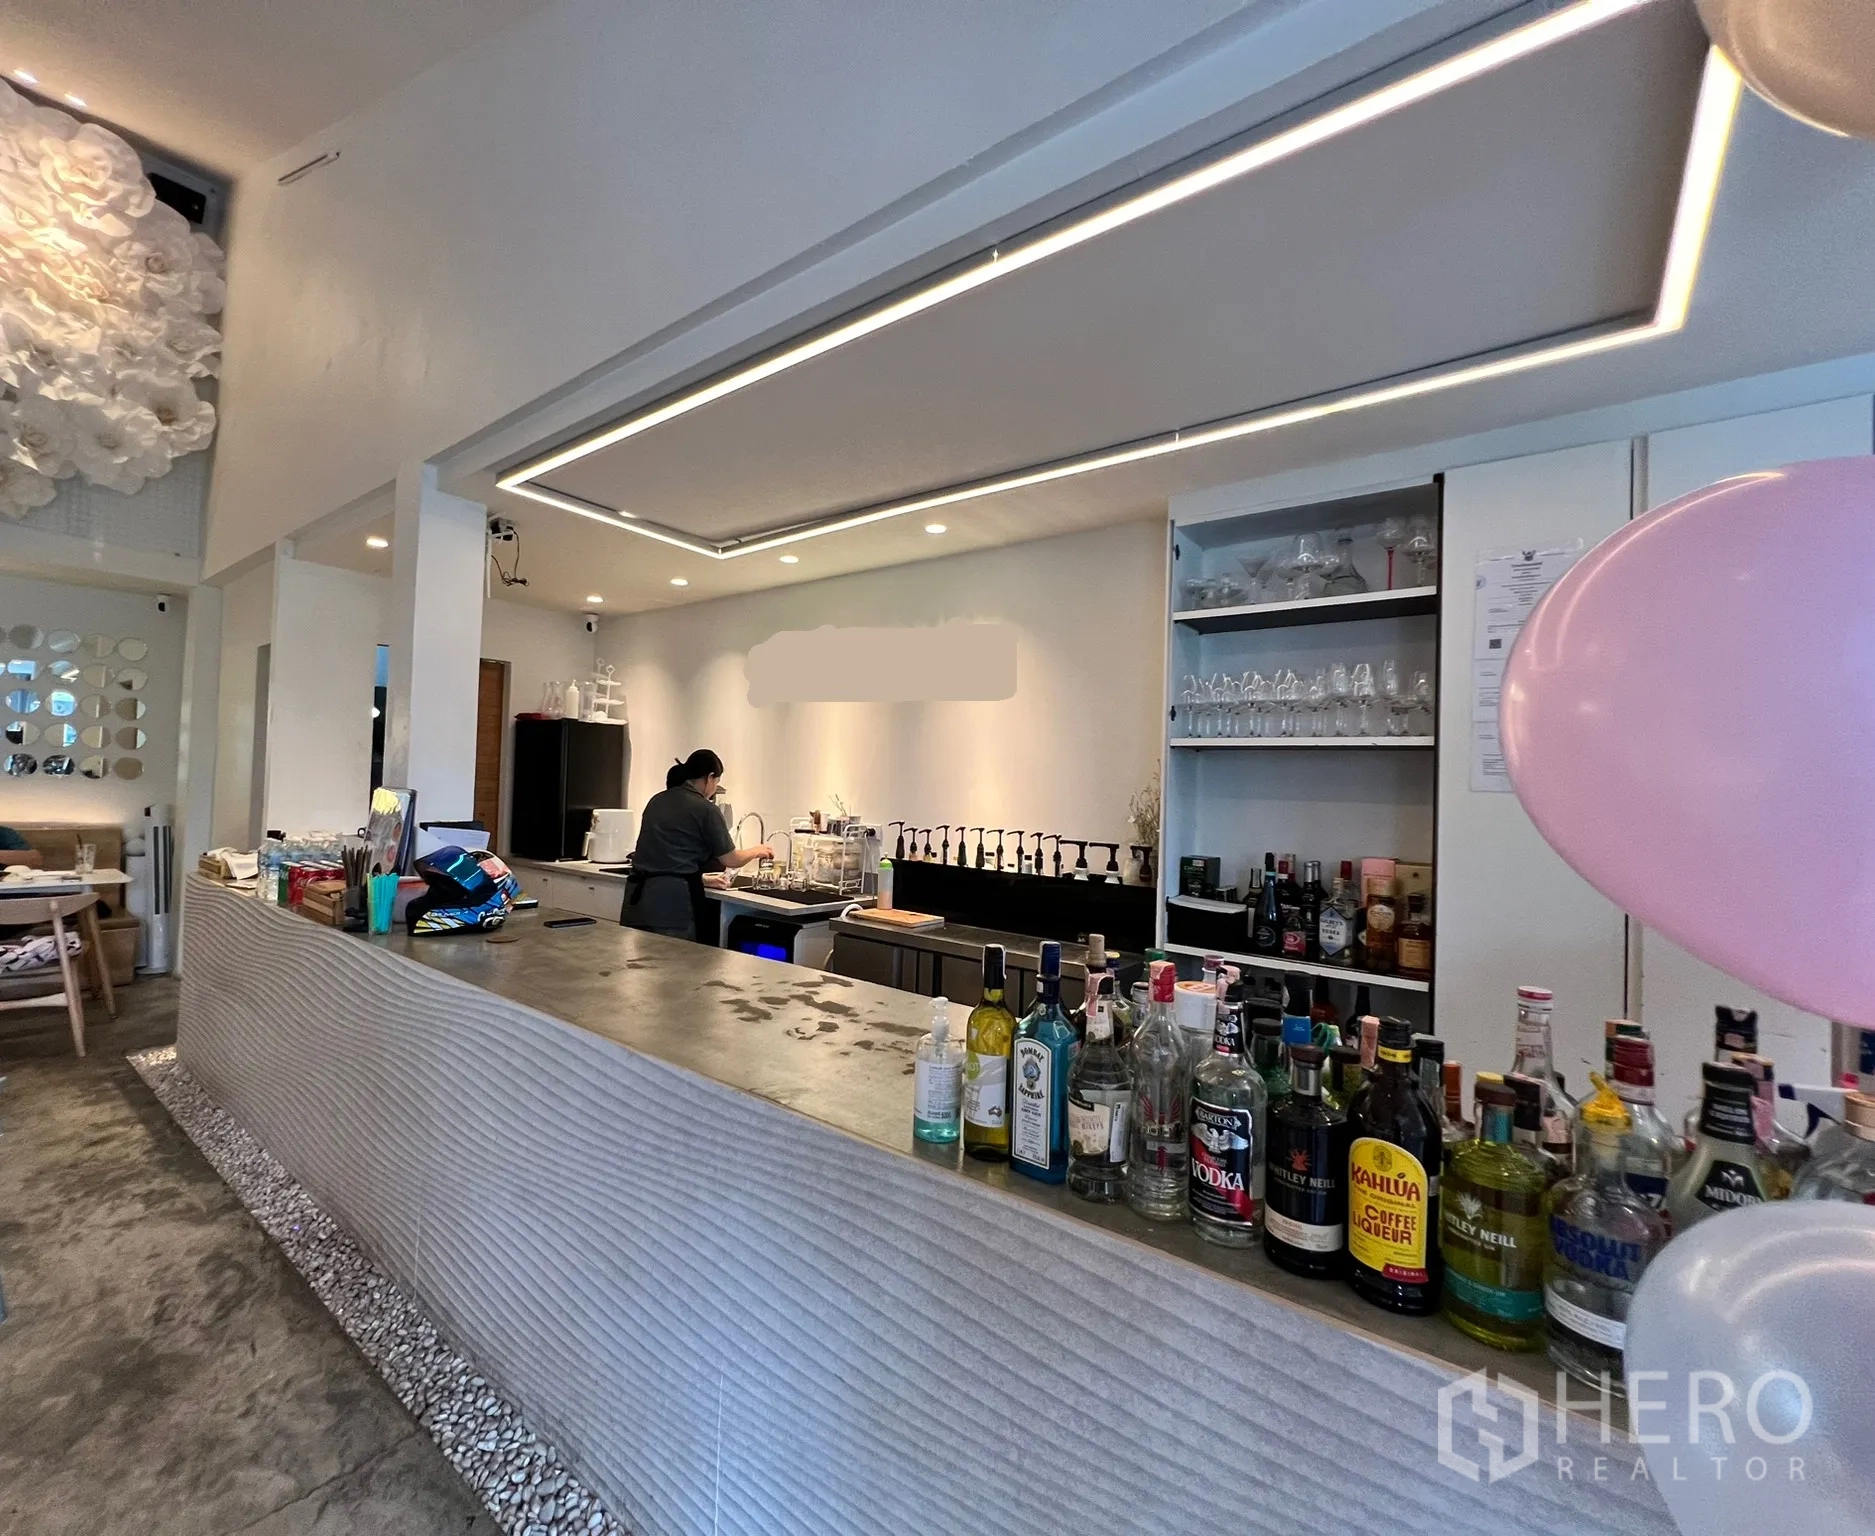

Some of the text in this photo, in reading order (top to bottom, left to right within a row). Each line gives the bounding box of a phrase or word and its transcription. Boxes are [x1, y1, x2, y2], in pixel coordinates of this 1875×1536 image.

[1020, 1047, 1045, 1063] BOMBAY
[1018, 1084, 1045, 1100] SAPPHIRE
[1200, 1109, 1233, 1126] BARTON
[1191, 1157, 1245, 1191] VODKA
[1351, 1161, 1421, 1202] KAHLÚA
[1352, 1210, 1412, 1246] LIQUEUR
[1364, 1204, 1417, 1231] COFFEE
[1480, 1228, 1518, 1249] NEILL
